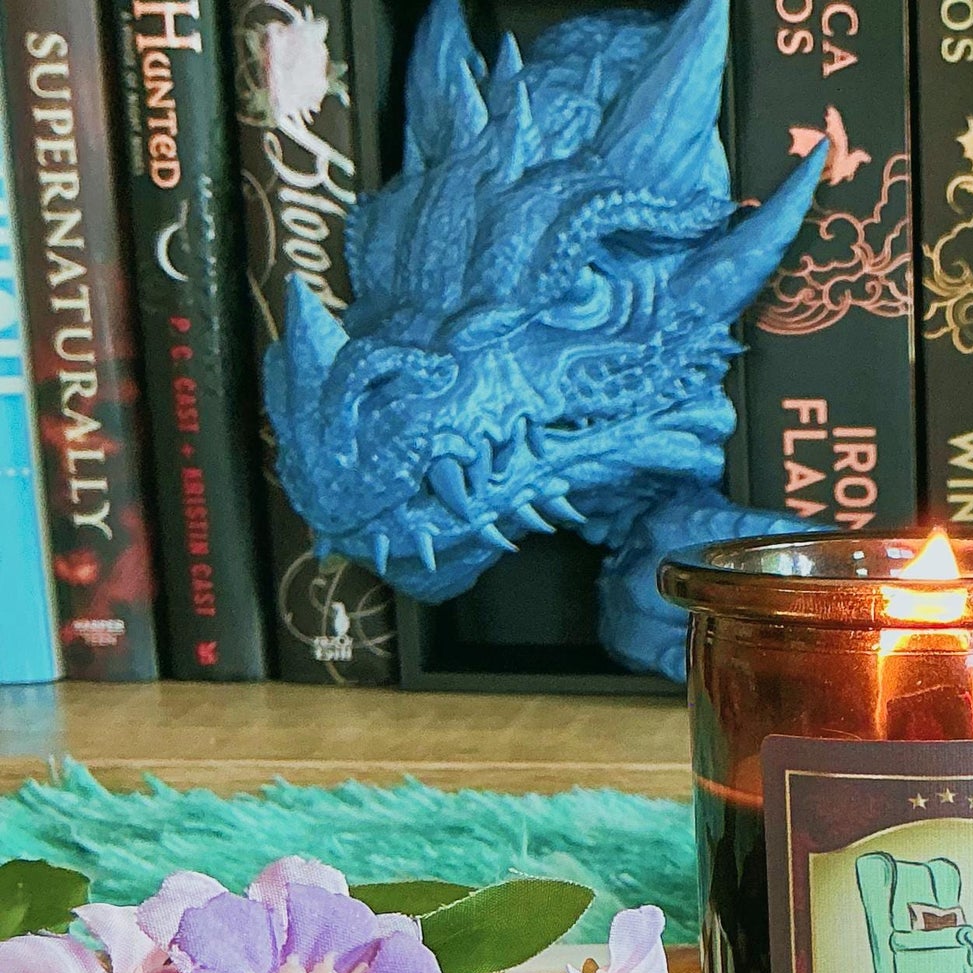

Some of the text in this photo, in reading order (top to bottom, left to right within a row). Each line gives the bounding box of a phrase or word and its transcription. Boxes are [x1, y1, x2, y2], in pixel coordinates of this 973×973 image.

[776, 0, 814, 56] OS
[821, 0, 858, 78] CA
[25, 31, 112, 540] SUPERNATURALLY
[171, 375, 201, 433] CAST
[190, 557, 217, 617] CAST
